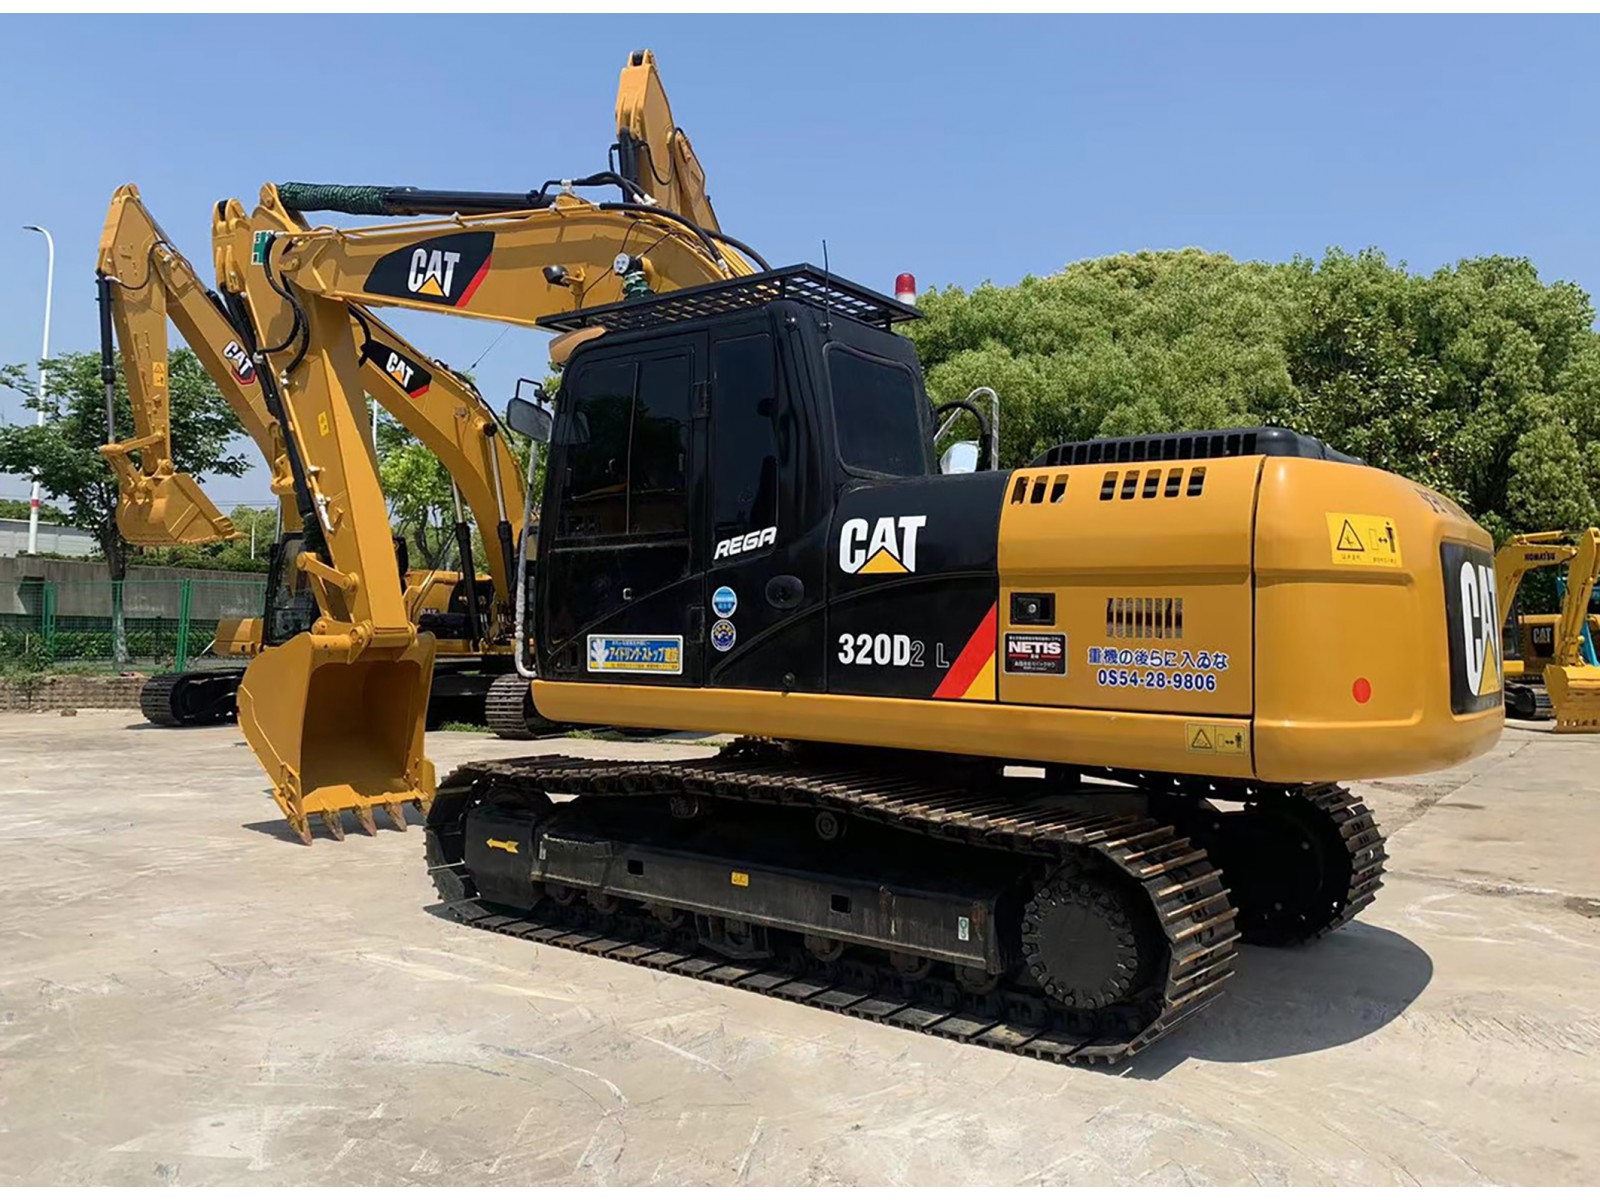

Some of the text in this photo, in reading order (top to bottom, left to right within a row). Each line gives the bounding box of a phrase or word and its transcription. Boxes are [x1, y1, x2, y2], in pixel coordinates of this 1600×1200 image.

[408, 248, 461, 298] CAT
[223, 341, 254, 376] CAT
[386, 352, 414, 388] CAT
[713, 526, 777, 560] REGA
[839, 515, 927, 575] CAT
[1524, 551, 1556, 561] KOMATSU
[1008, 641, 1062, 655] NETIS
[1533, 627, 1552, 644] CAT
[935, 643, 950, 668] L
